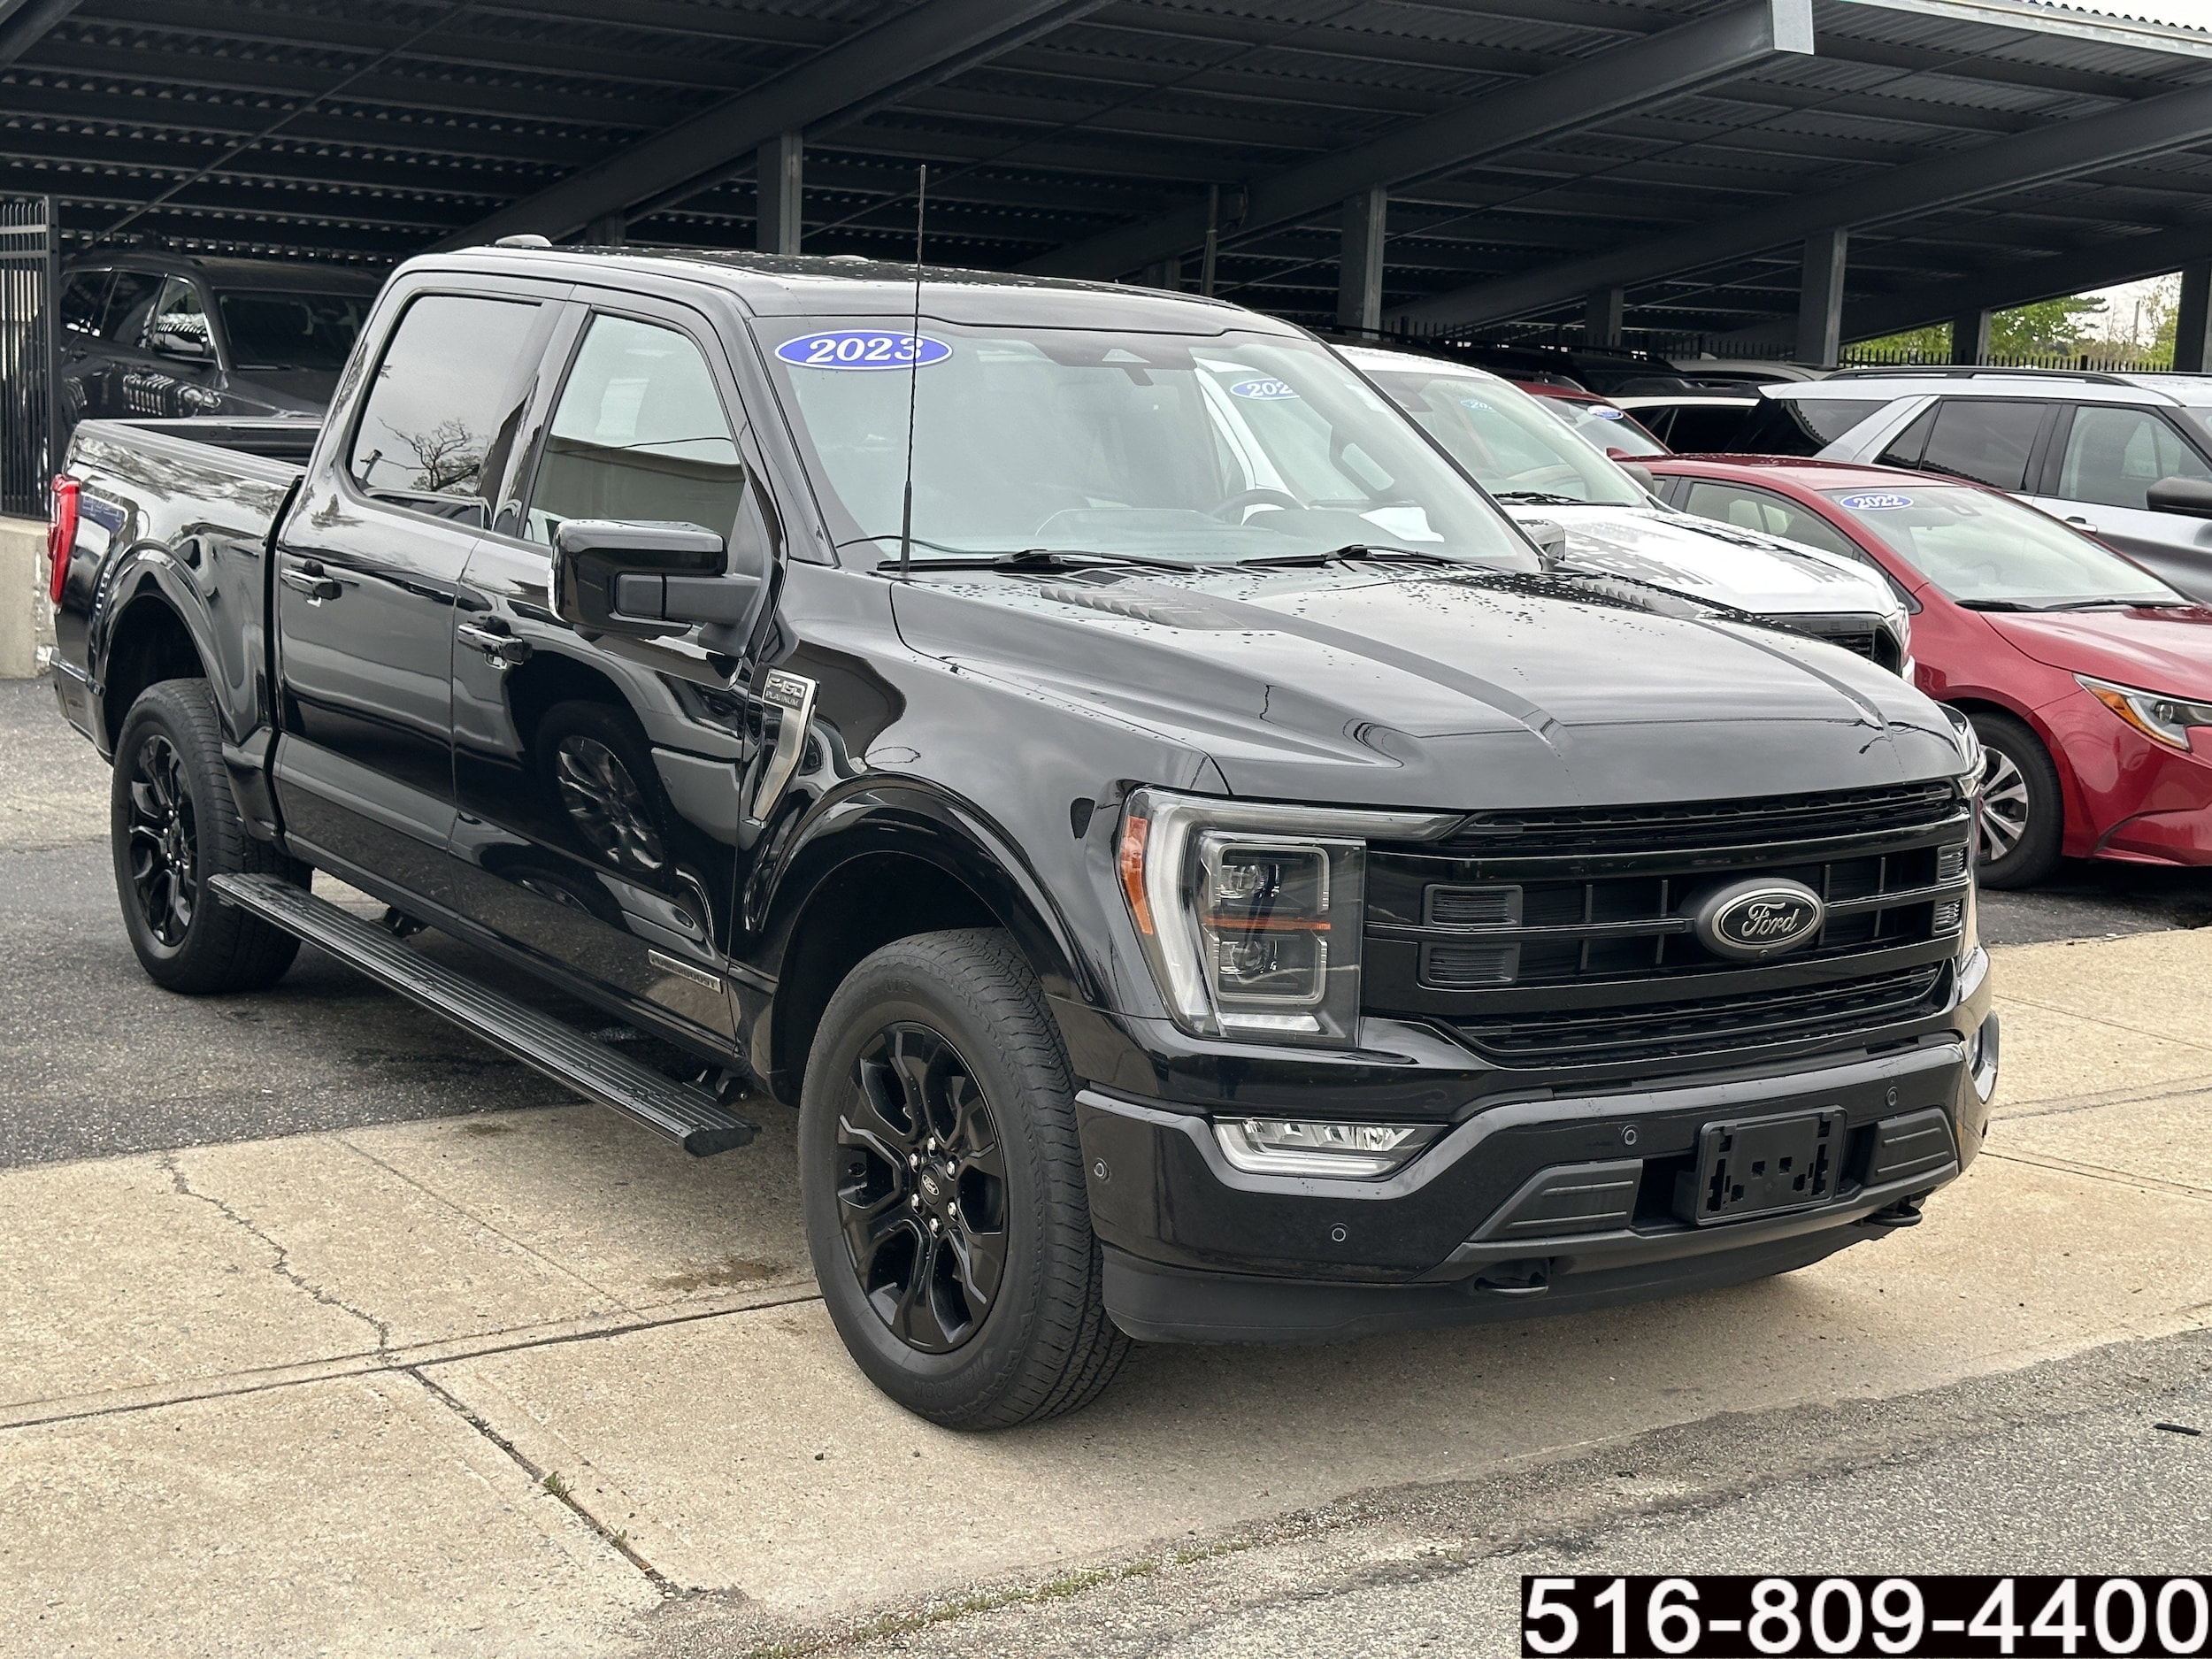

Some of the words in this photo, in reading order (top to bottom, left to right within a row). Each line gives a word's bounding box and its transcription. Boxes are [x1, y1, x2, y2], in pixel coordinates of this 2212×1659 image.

[805, 337, 924, 363] 2023
[1246, 381, 1294, 397] 202
[1853, 495, 1903, 509] 2022
[764, 690, 800, 707] PLATINUM
[1740, 902, 1800, 937] Ford
